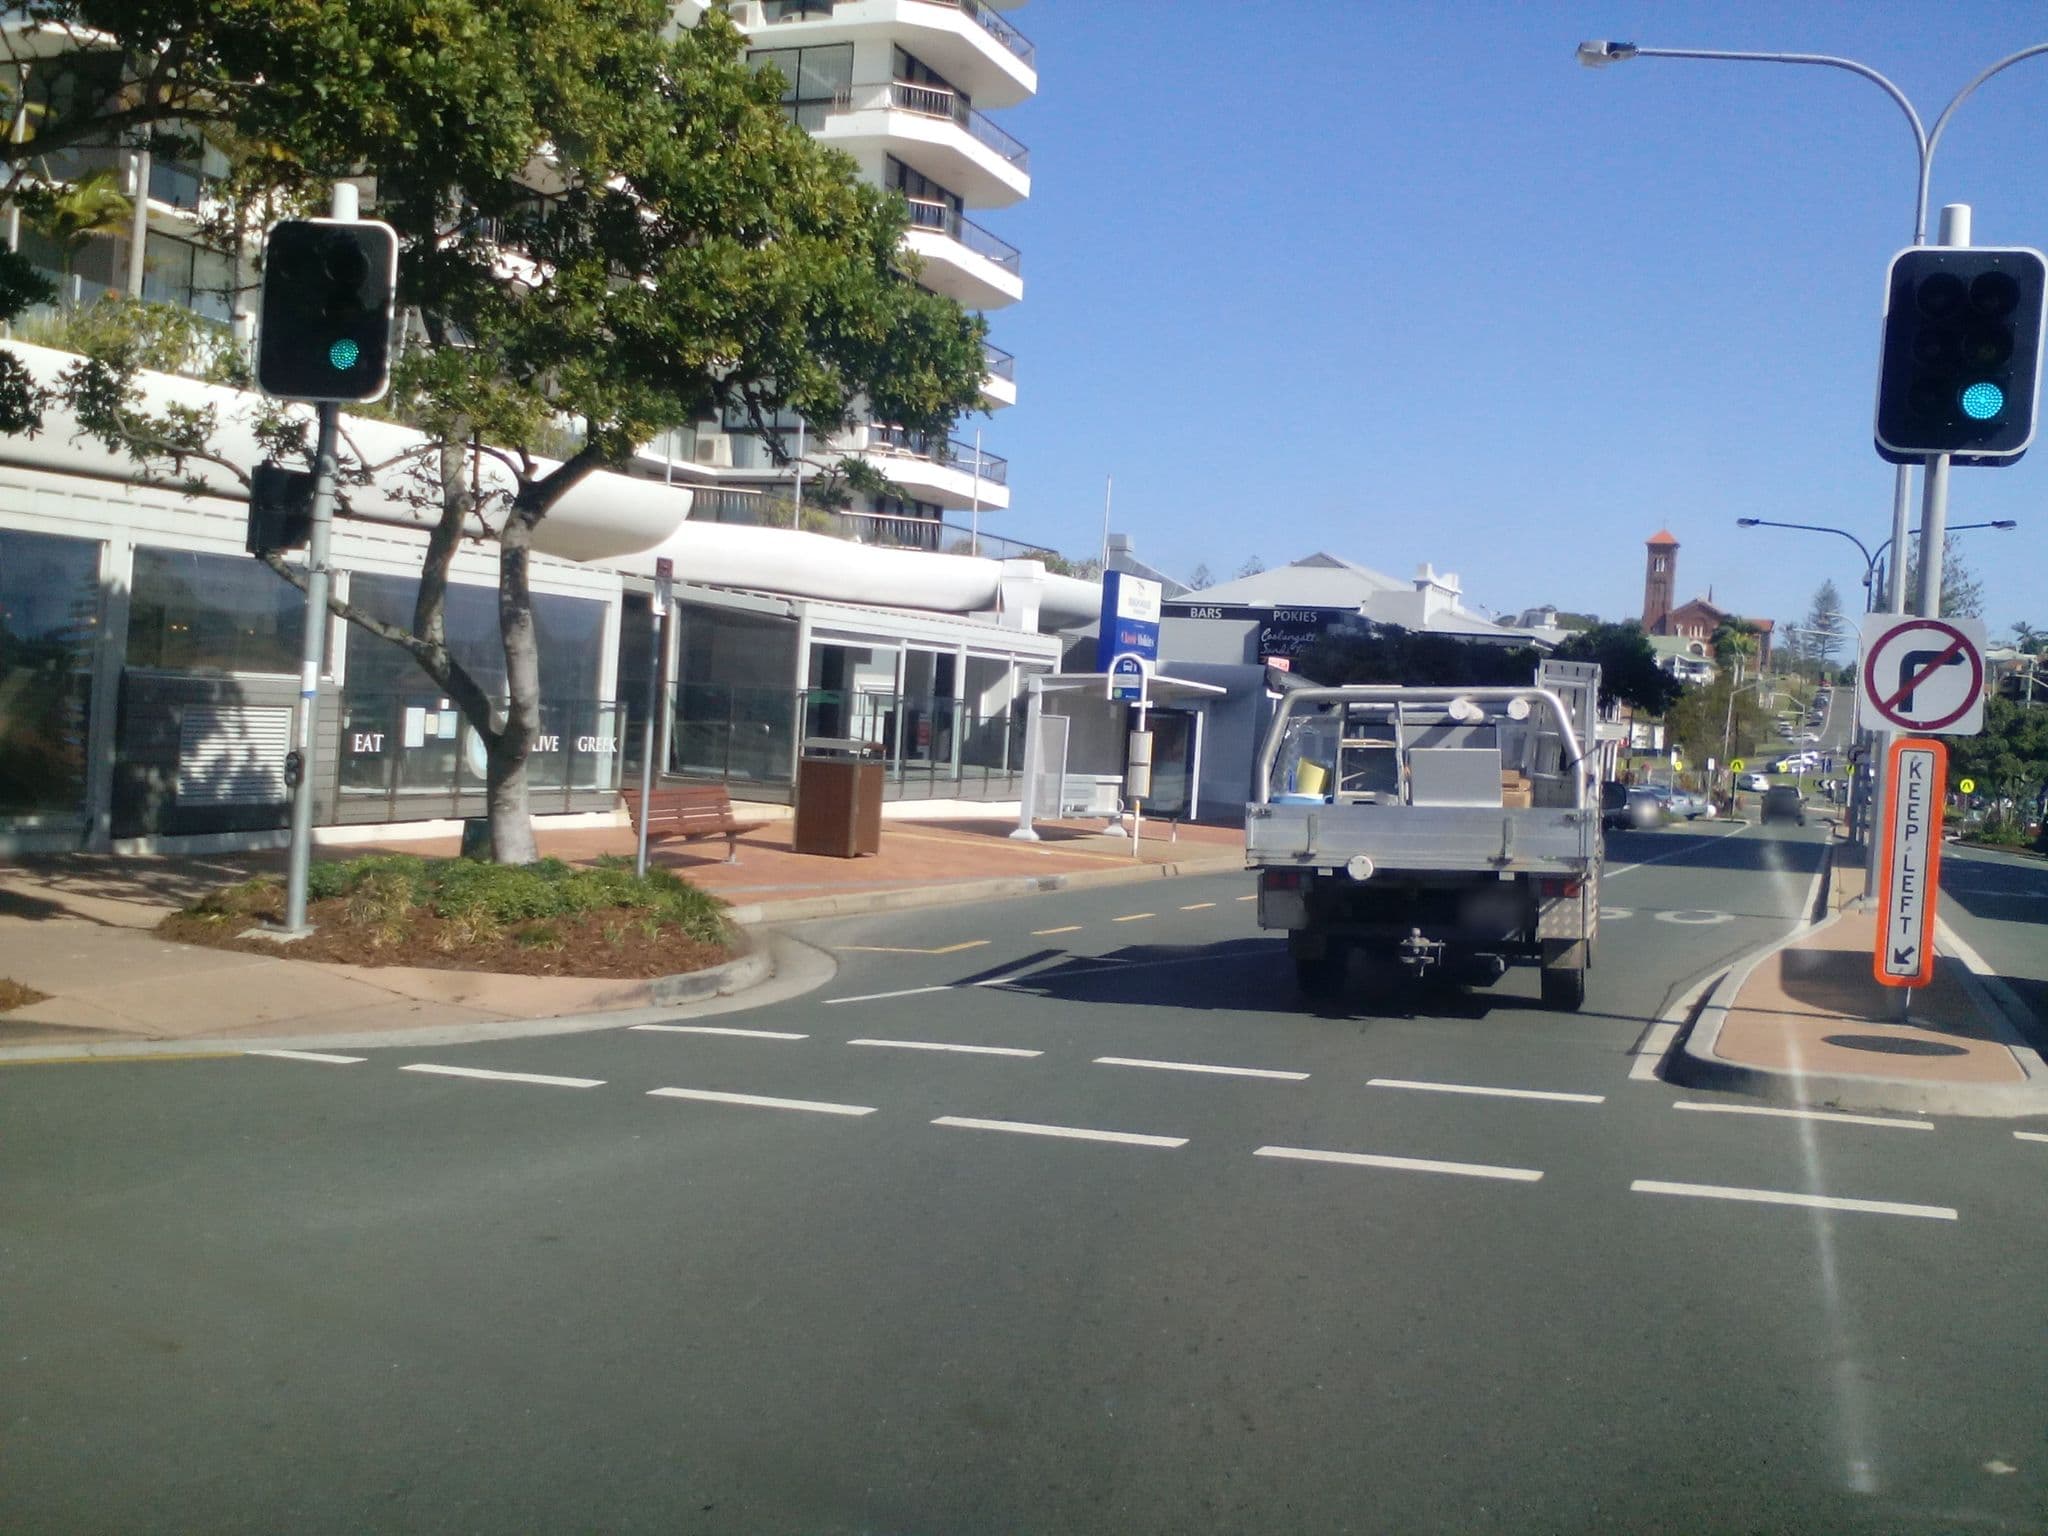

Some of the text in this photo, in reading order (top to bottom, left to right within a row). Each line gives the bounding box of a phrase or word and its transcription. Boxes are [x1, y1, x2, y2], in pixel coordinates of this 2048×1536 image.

[1190, 607, 1222, 619] BARS
[1273, 610, 1318, 623] POKIES
[1260, 627, 1317, 650] Coolangatt
[354, 733, 384, 752] EAT
[577, 735, 618, 753] GREEK
[1900, 761, 1922, 935] KEEP LEFT
